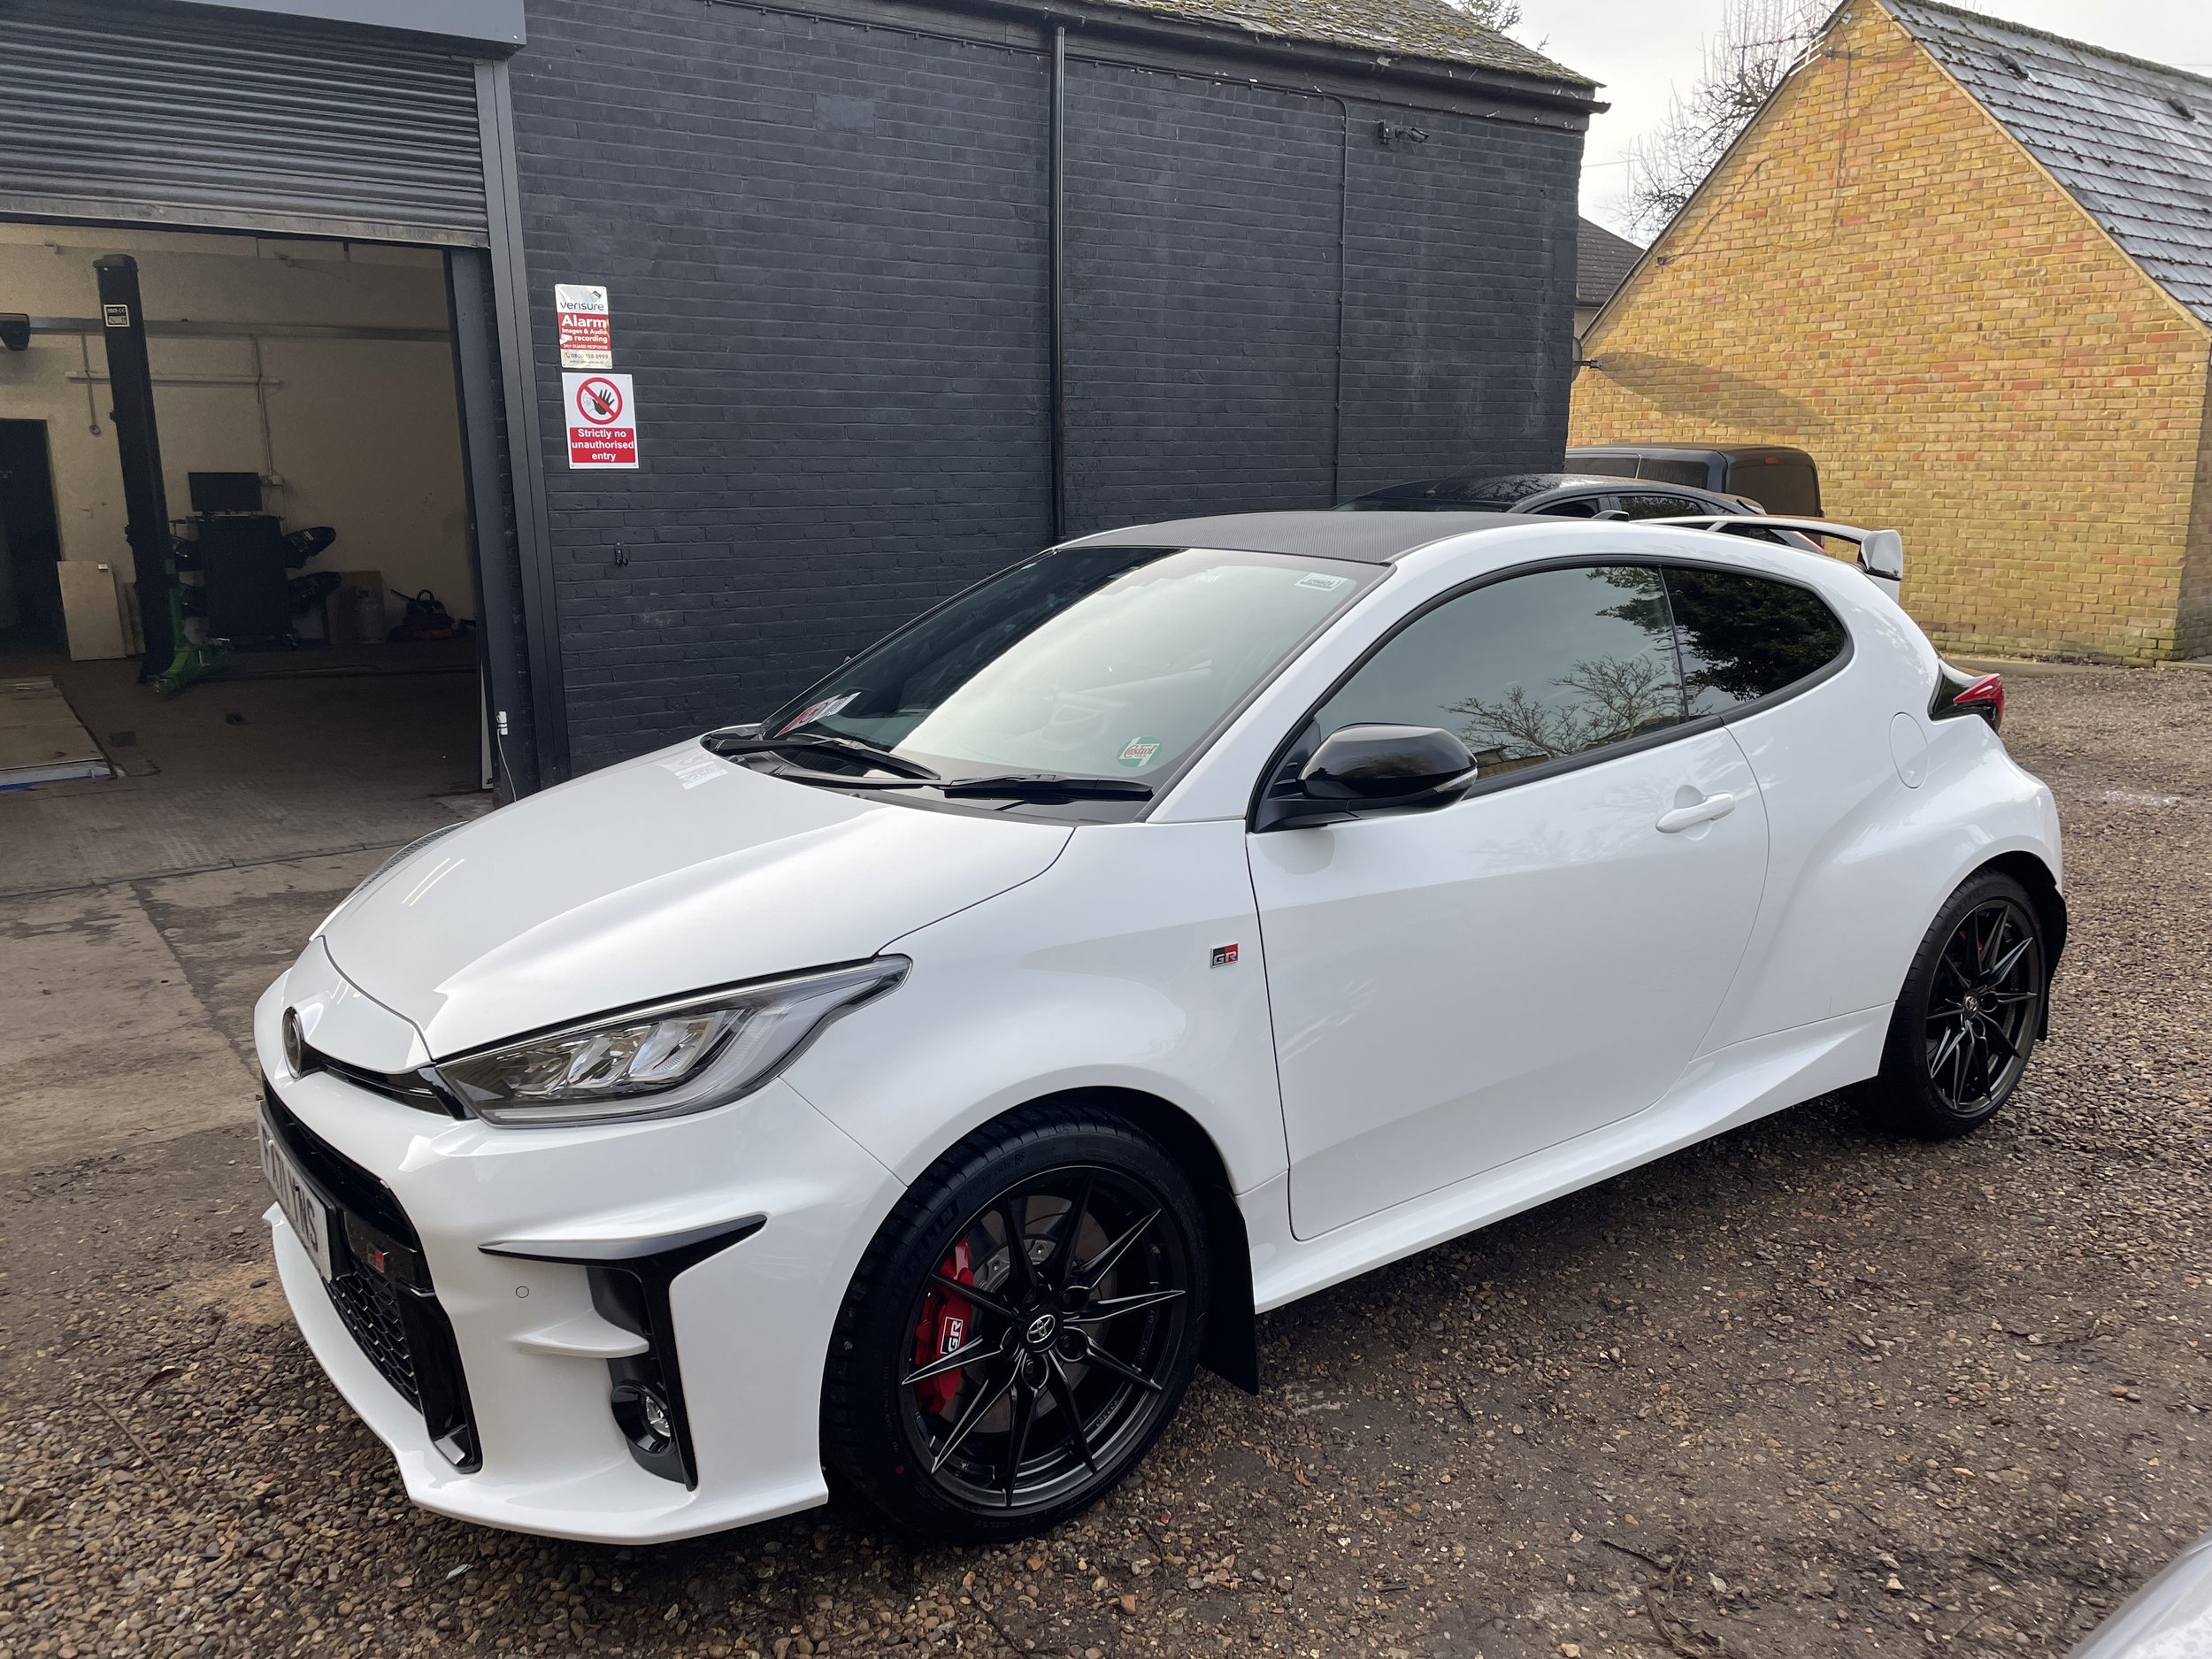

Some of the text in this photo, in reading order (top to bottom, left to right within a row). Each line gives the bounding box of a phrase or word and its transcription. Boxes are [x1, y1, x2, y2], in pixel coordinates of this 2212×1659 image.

[560, 302, 604, 311] verisure
[561, 314, 607, 327] Alarm
[578, 428, 611, 439] Strictly
[591, 452, 616, 462] entry
[1124, 744, 1157, 758] Castrol
[1213, 951, 1237, 964] GR
[948, 1320, 962, 1352] GR
